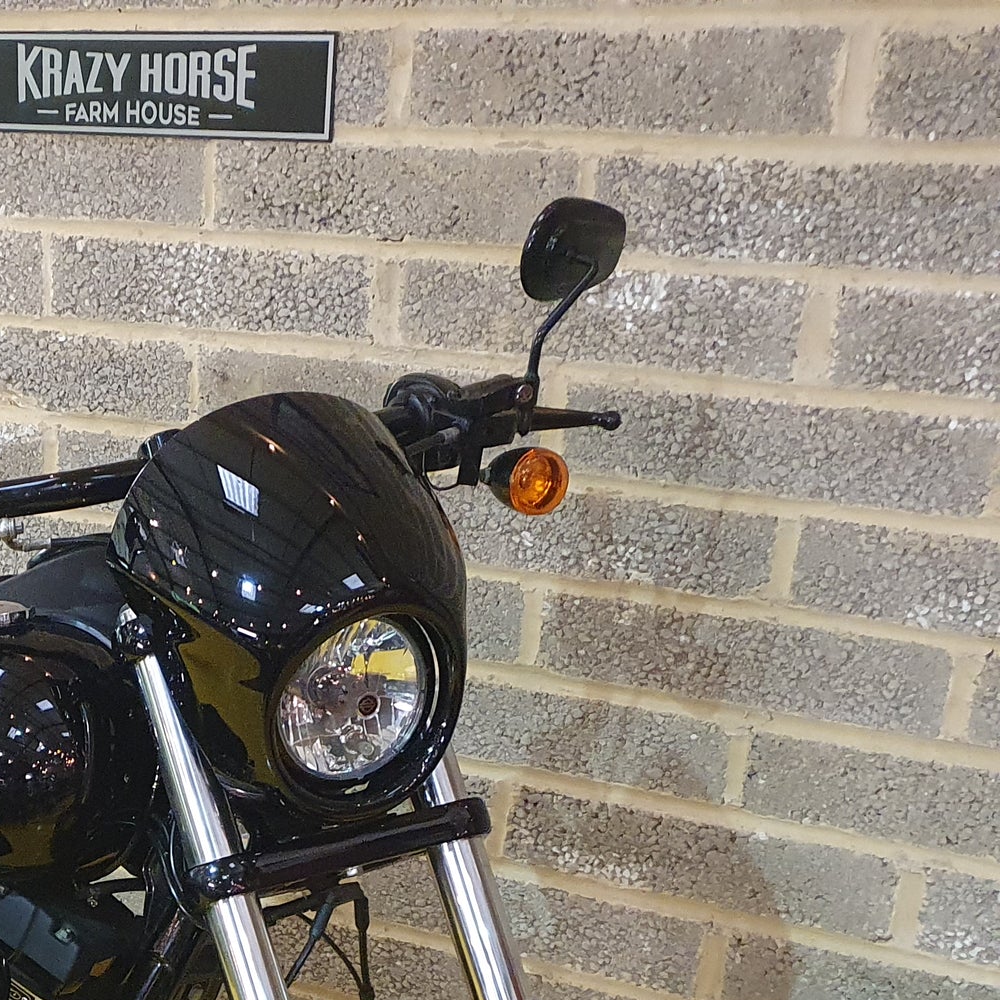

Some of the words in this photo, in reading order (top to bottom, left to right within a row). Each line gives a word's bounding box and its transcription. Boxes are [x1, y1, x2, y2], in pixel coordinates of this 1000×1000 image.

[17, 42, 132, 103] KRAZY
[140, 43, 257, 110] HORSE
[65, 101, 119, 124] FARM
[126, 100, 200, 126] HOUSE
